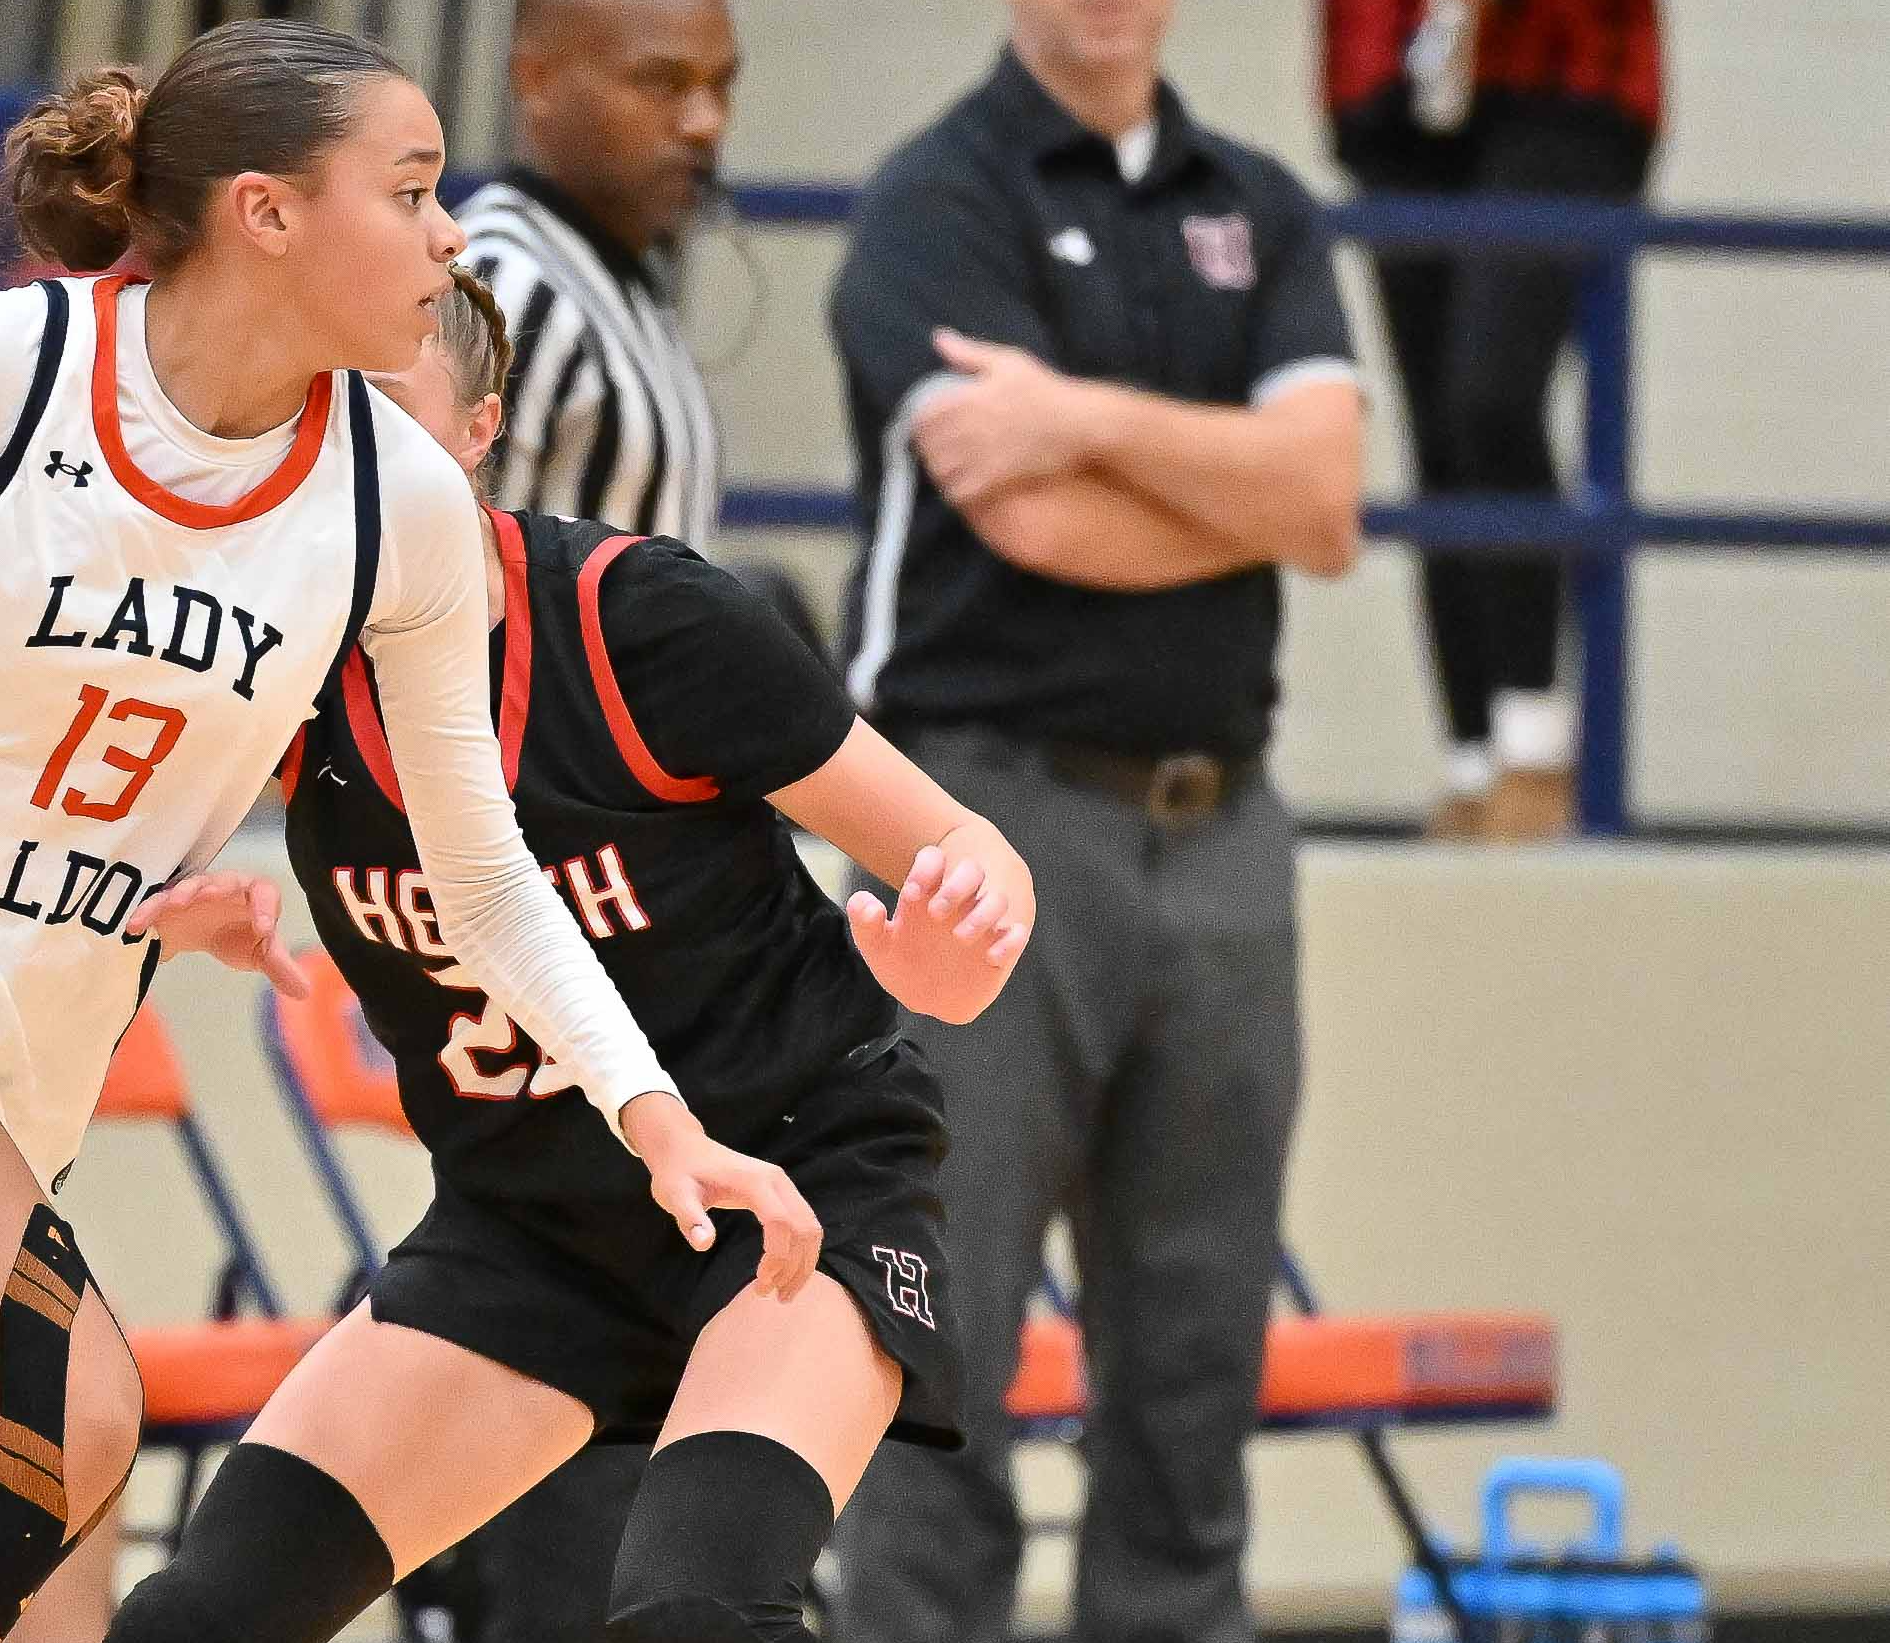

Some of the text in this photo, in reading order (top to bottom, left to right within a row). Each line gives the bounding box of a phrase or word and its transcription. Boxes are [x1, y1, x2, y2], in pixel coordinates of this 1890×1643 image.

[25, 574, 284, 701] LADY
[29, 684, 188, 823] 13
[871, 1244, 936, 1332] H
